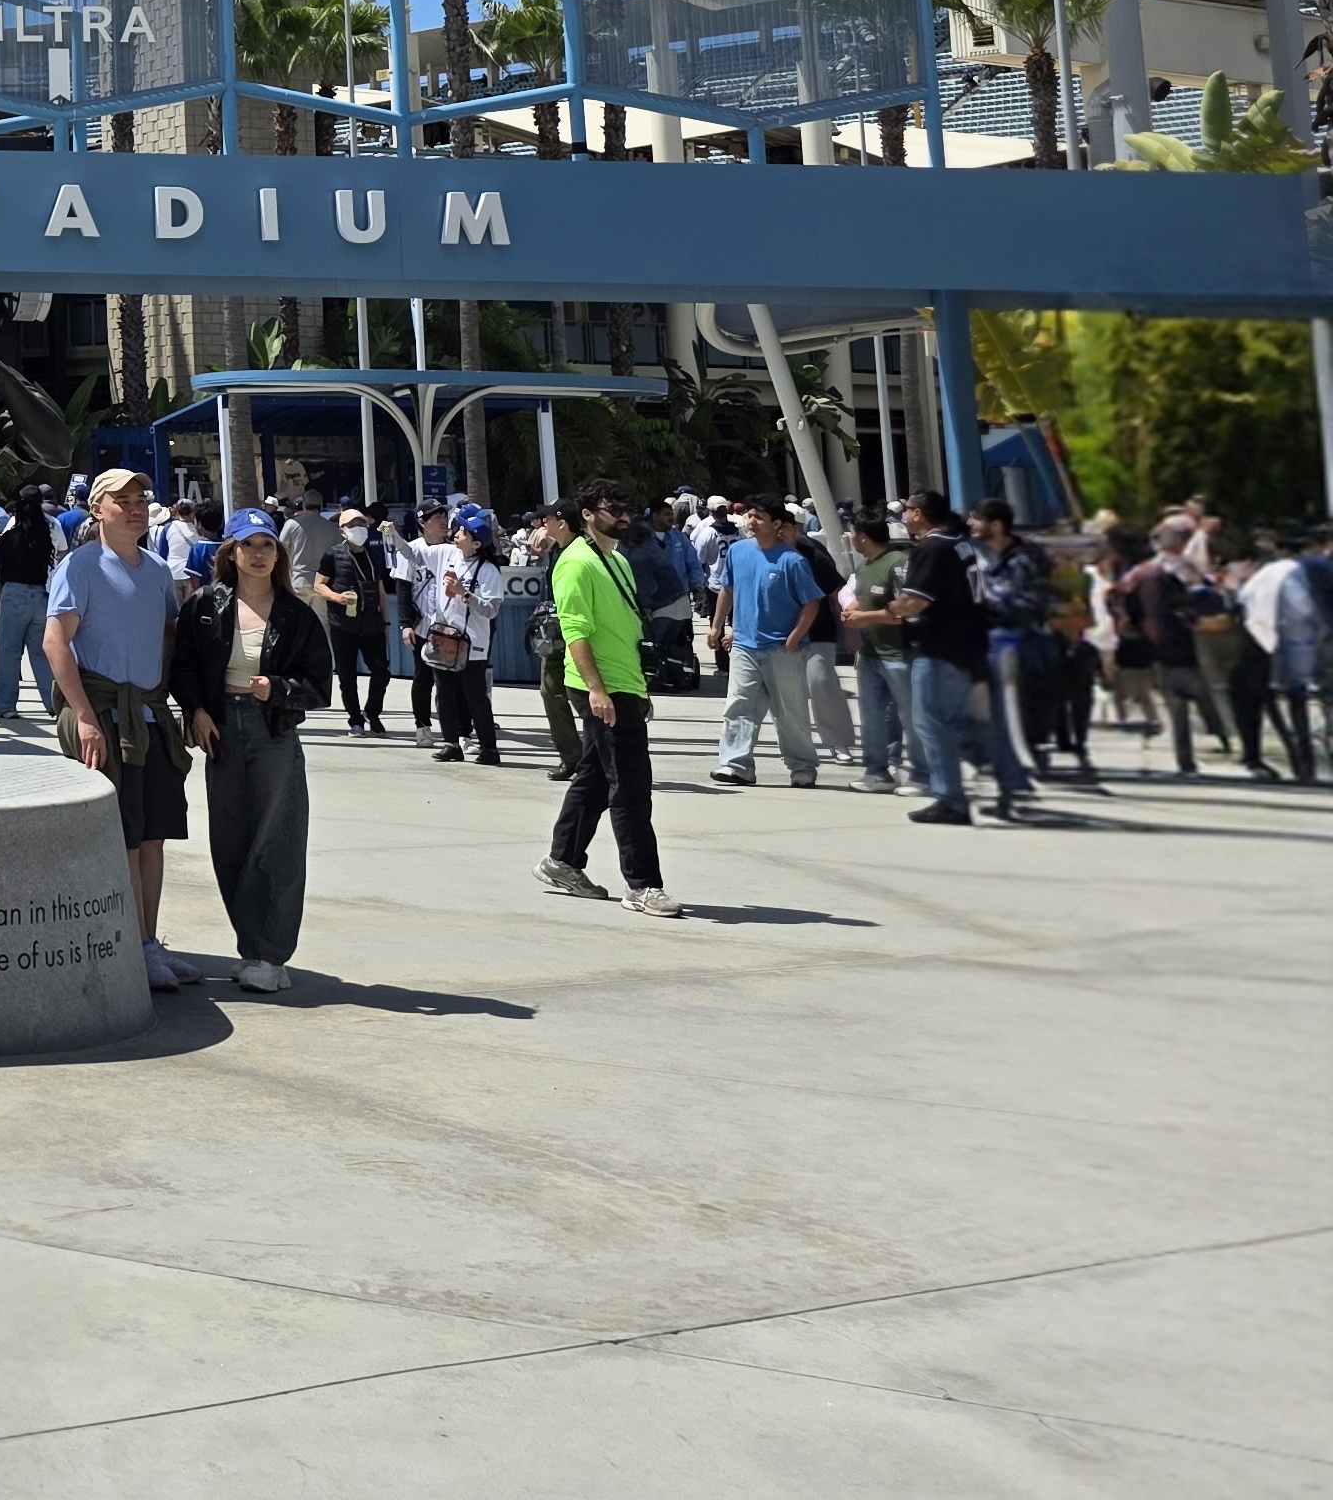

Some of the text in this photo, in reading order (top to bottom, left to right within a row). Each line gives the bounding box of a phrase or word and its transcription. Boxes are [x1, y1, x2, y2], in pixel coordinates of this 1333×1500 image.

[30, 901, 45, 924] in
[52, 897, 80, 922] this
[84, 889, 125, 918] country
[17, 940, 39, 969] of
[45, 950, 64, 967] us
[70, 941, 82, 964] is
